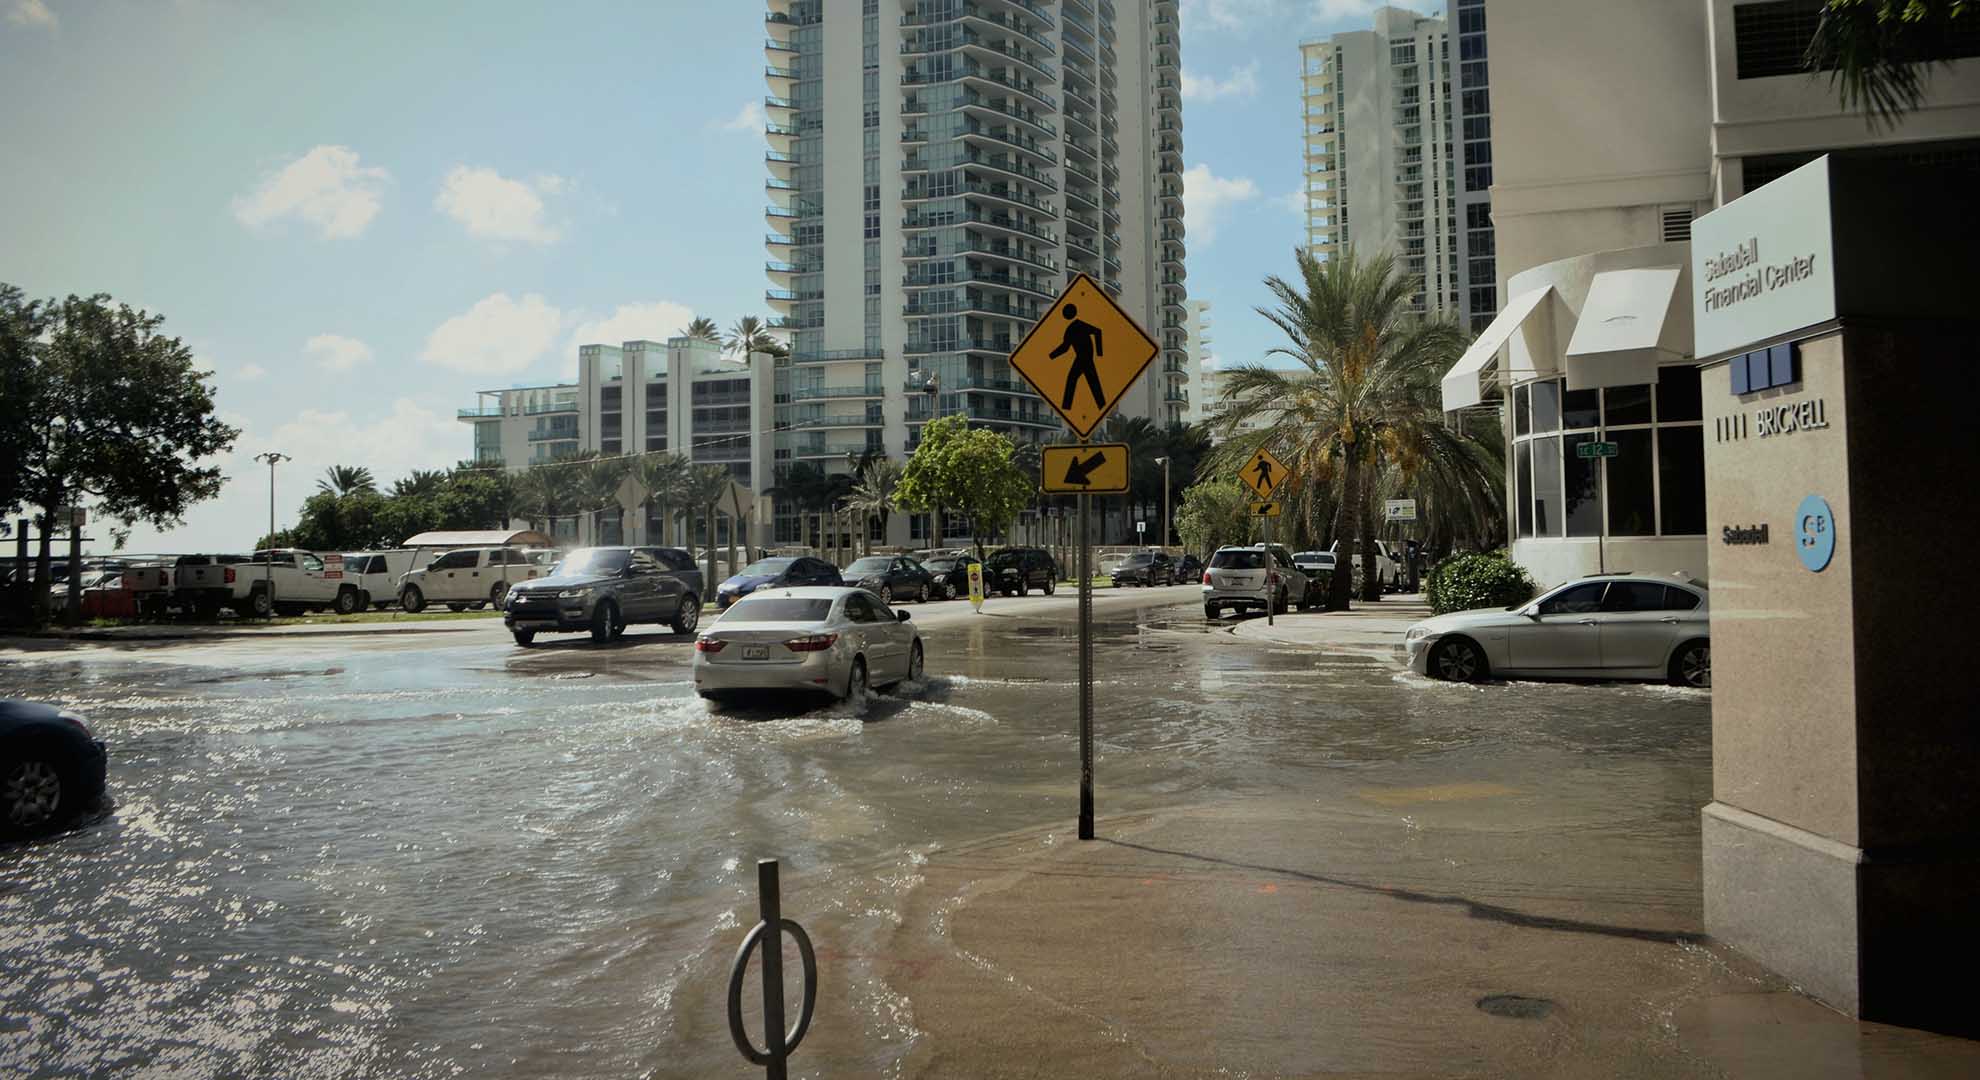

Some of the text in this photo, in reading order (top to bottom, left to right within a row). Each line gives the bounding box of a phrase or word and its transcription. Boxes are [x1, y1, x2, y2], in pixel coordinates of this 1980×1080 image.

[1705, 237, 1758, 282] Sabadell
[1705, 253, 1815, 312] Financial Center
[1714, 398, 1829, 443] 1111 BRICKELL
[1722, 523, 1769, 546] Sabadell
